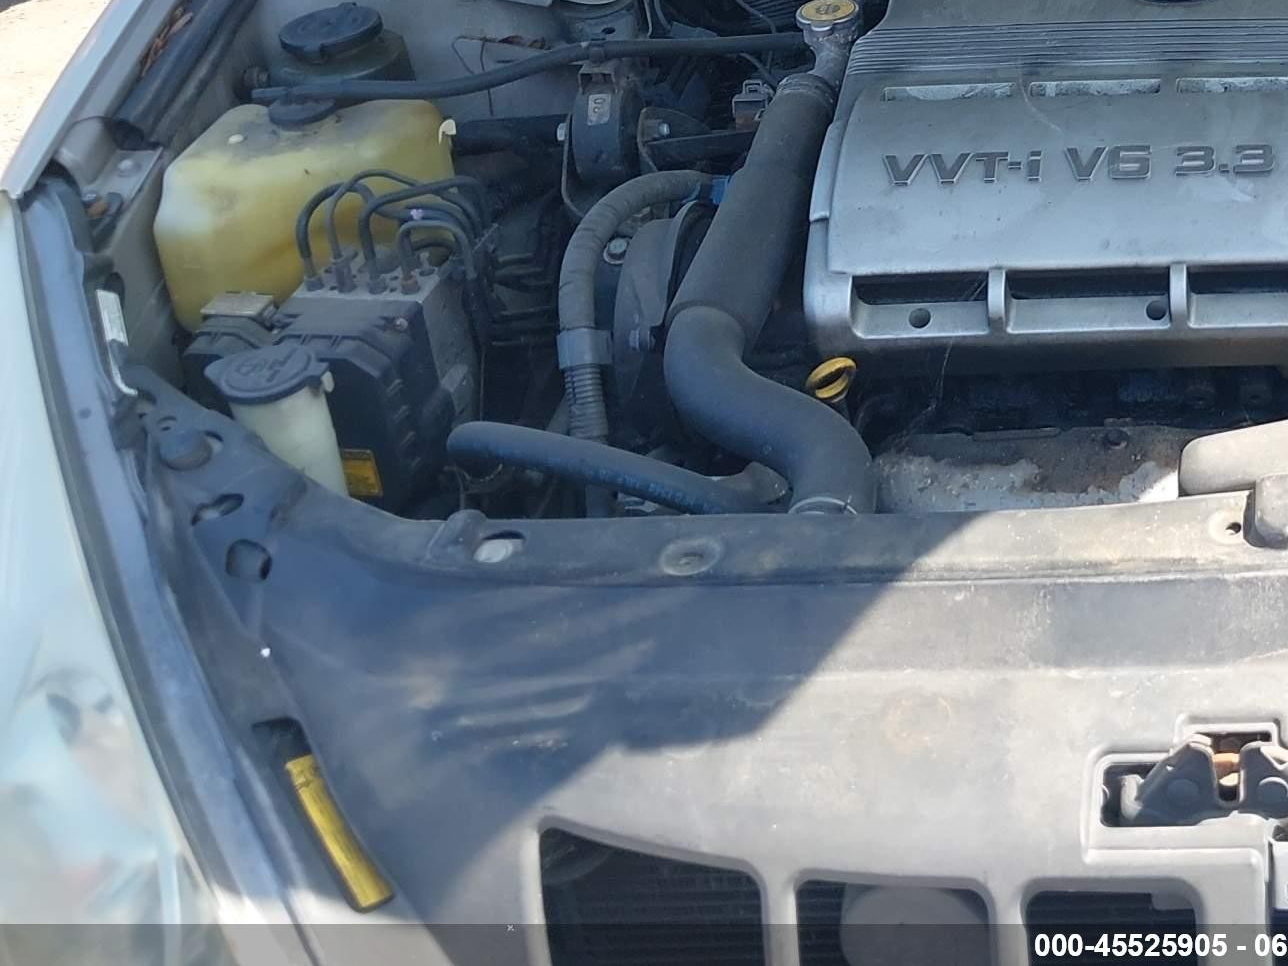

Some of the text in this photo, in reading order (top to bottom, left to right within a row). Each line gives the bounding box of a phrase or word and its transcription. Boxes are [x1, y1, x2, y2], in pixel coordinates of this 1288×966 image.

[882, 143, 1276, 187] VVT-i V6 3.3
